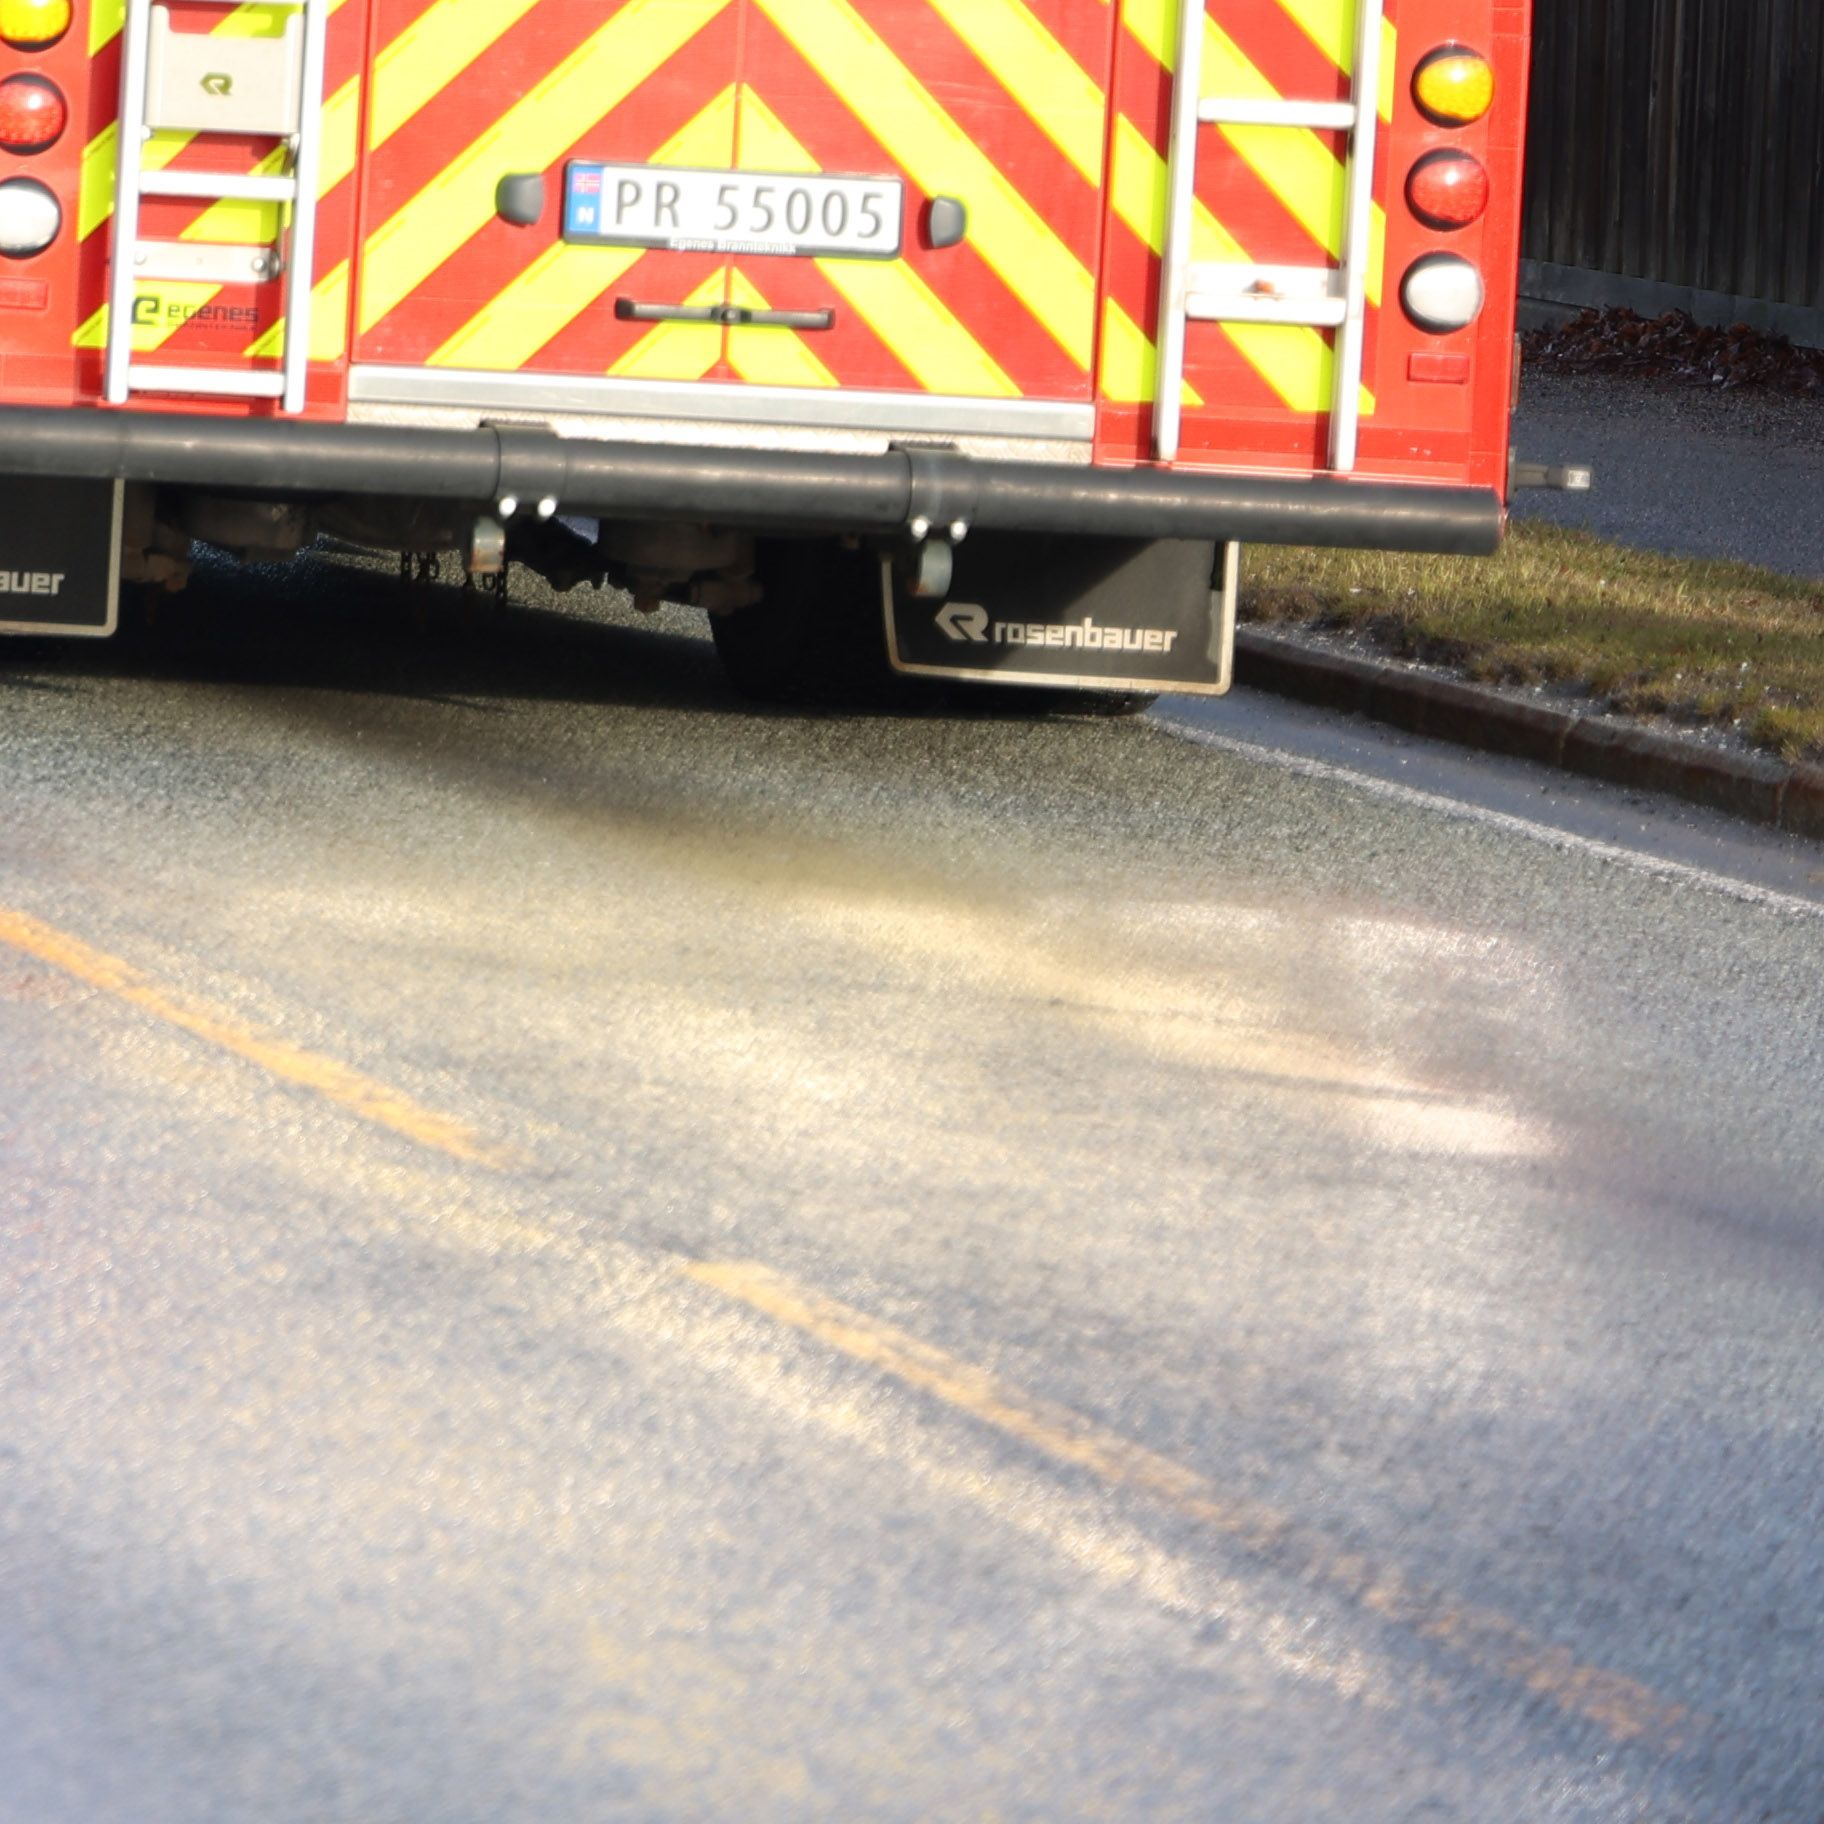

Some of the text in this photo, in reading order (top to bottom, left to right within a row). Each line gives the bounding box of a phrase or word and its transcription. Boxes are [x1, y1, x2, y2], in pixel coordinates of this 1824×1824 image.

[614, 179, 884, 238] PR 55005
[994, 617, 1178, 653] rosenbauer
